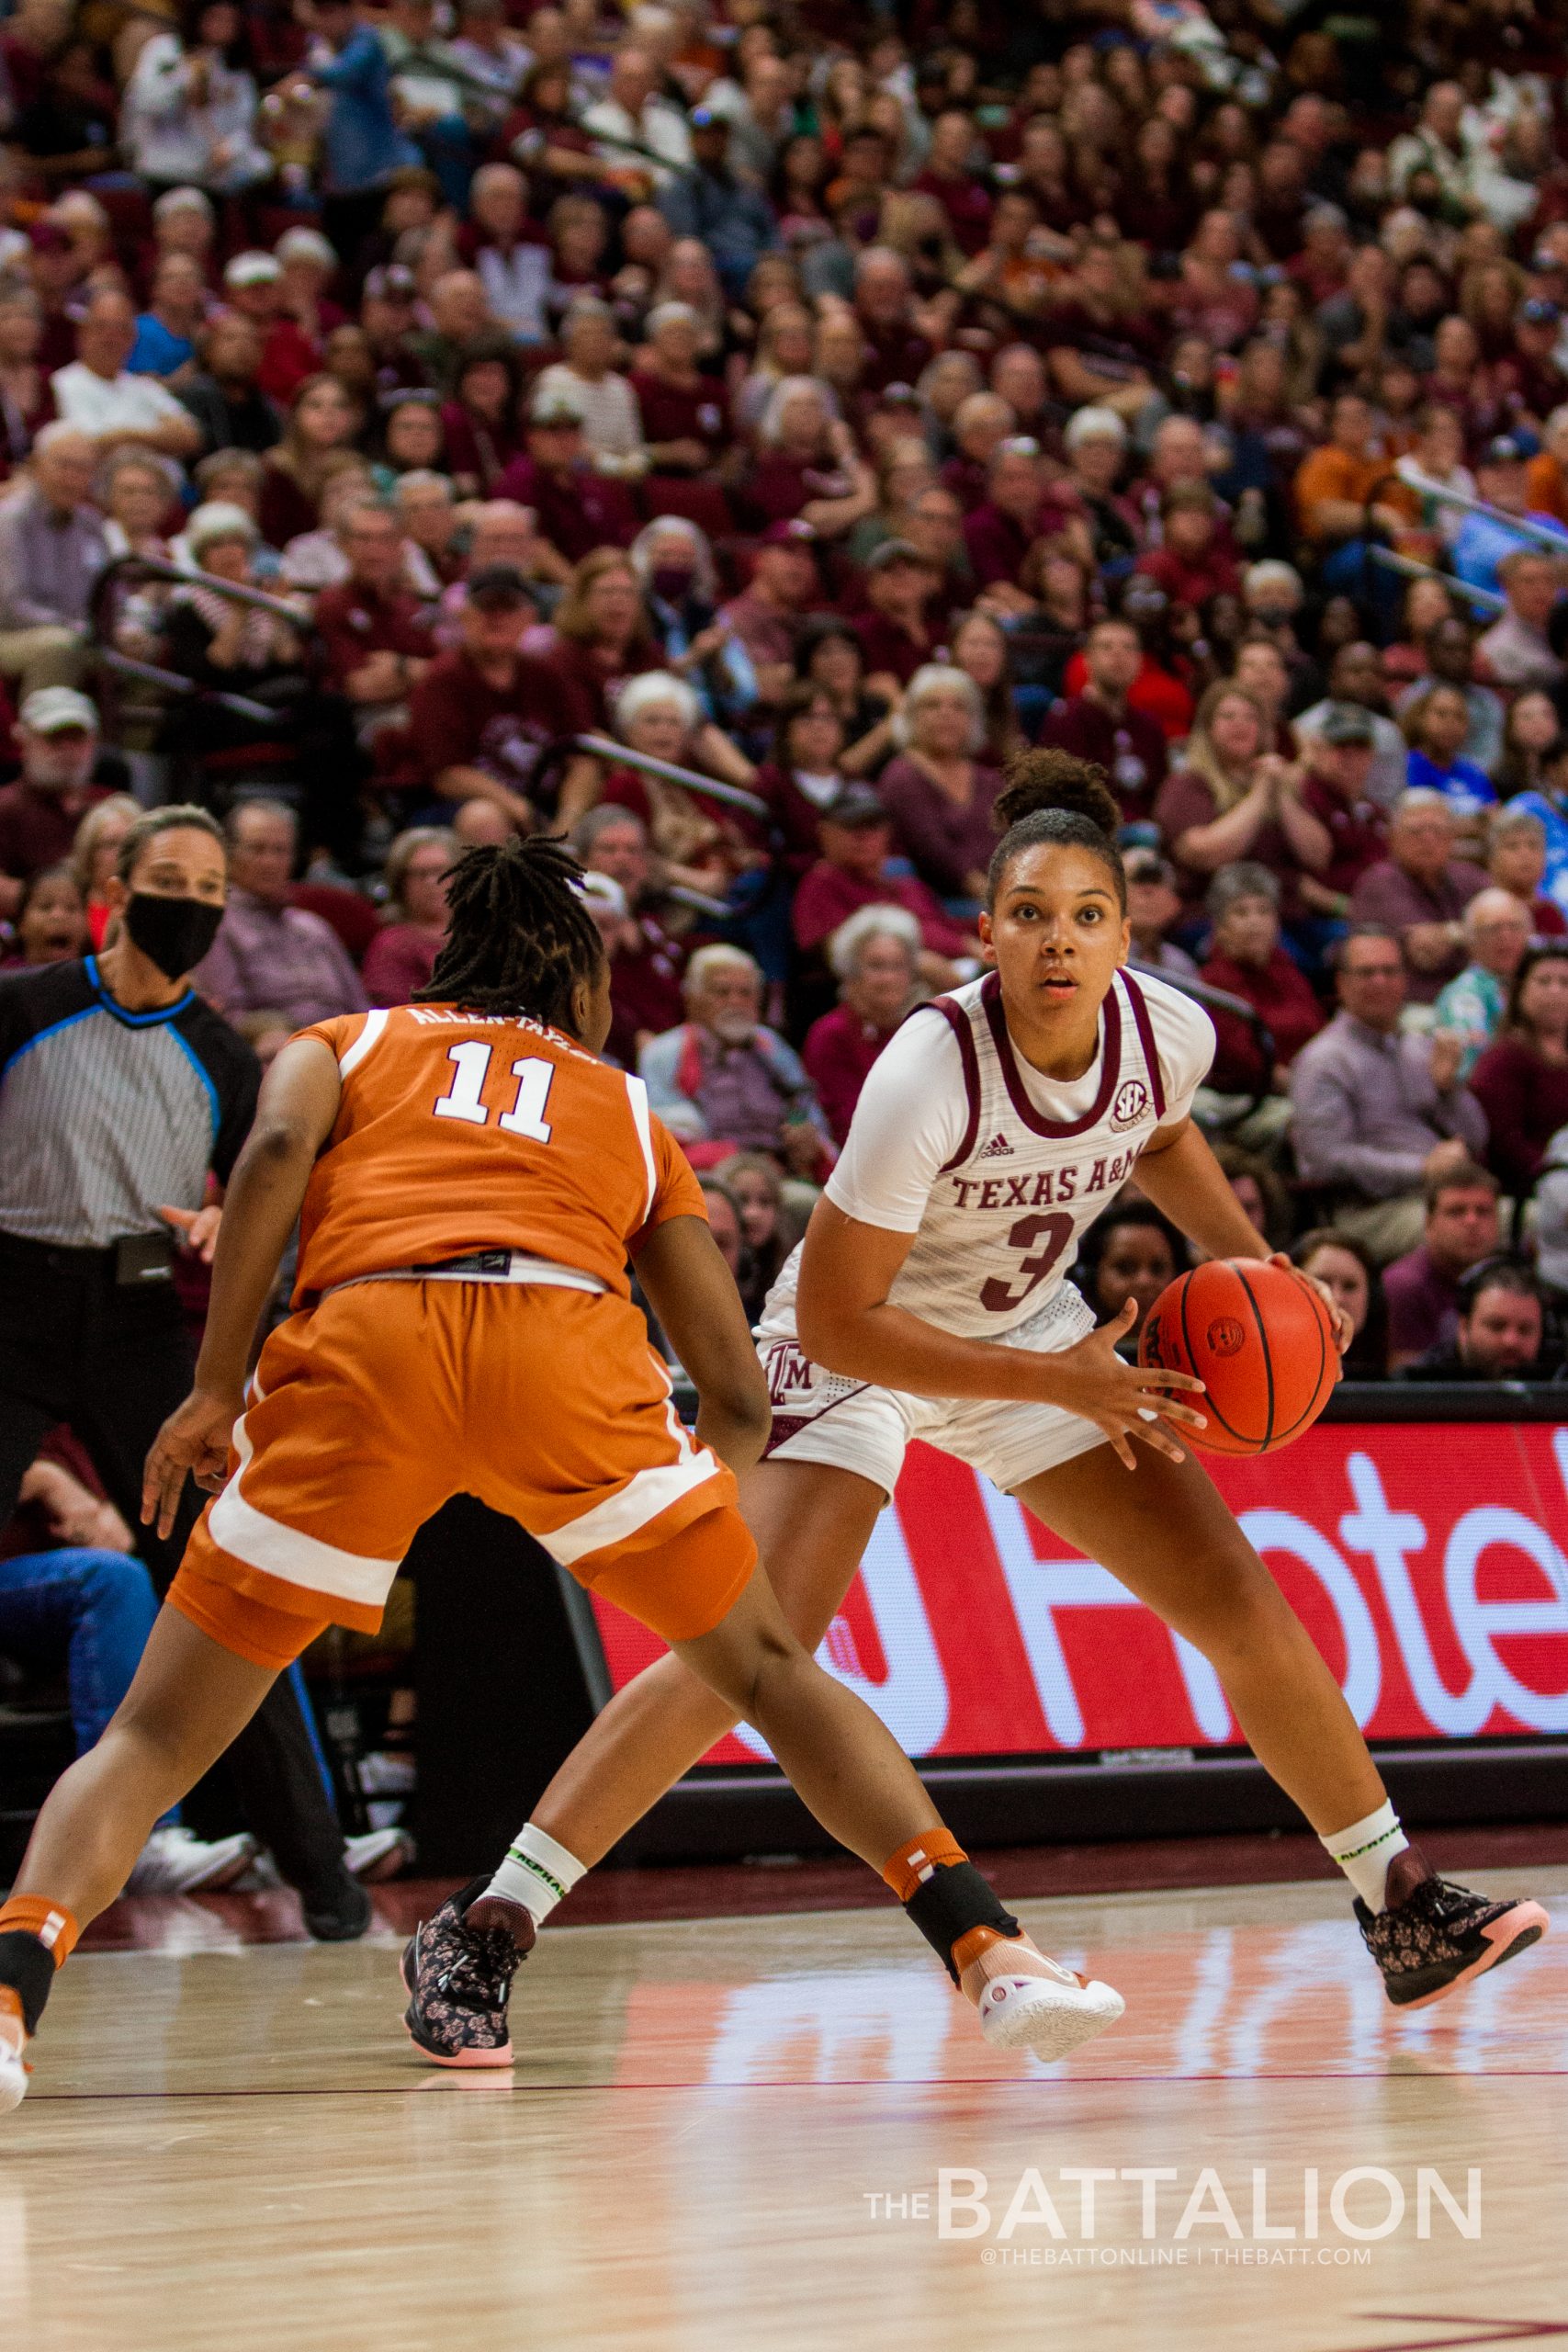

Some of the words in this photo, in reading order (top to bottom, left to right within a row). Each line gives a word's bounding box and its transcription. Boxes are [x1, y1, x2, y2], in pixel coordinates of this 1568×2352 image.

[433, 1039, 555, 1145] 11
[1115, 1082, 1145, 1120] SEC
[952, 1165, 1078, 1209] TEXAS
[1085, 1138, 1145, 1193] A&M
[980, 1148, 1015, 1159] adidas
[979, 1212, 1076, 1312] 3
[974, 1427, 1568, 1749] Hote
